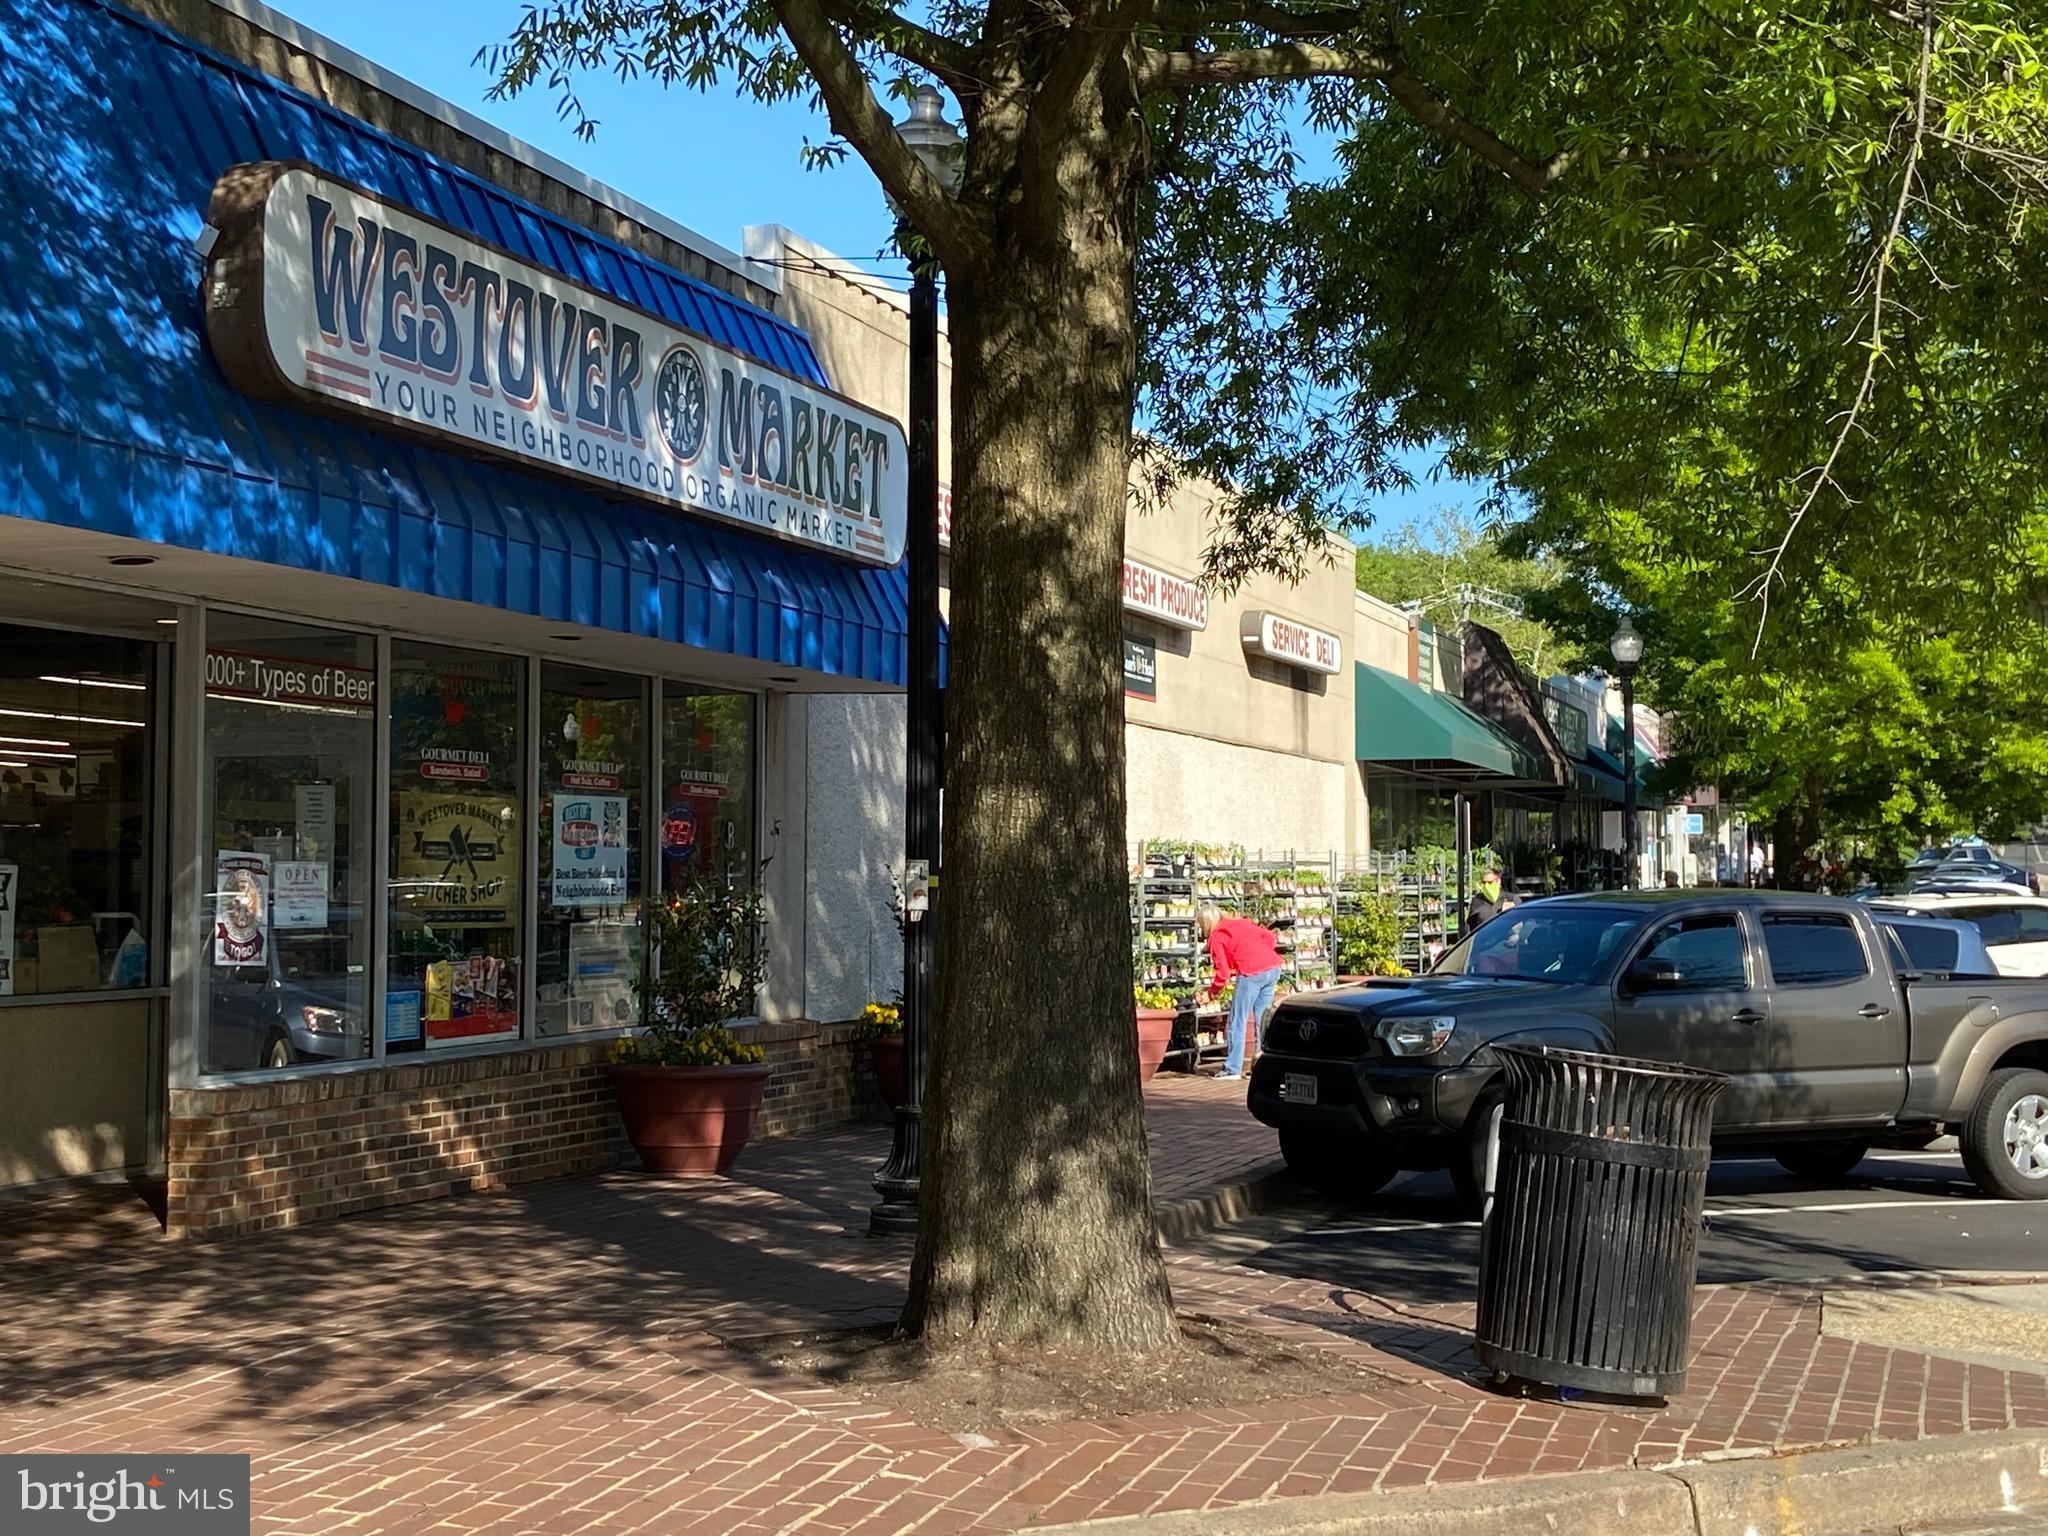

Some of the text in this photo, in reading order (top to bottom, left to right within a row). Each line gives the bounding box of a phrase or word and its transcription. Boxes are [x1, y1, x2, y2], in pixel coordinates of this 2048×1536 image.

[306, 194, 890, 527] WESTOVER MARKET
[375, 372, 853, 550] YOUR NEIGHBORHOOD ORGANIC MARKET
[1123, 563, 1205, 624] RESH PRODUCE
[1271, 619, 1335, 667] SERVICE DELI
[250, 659, 307, 698] Types
[311, 668, 331, 696] of
[333, 669, 376, 701] Beer
[420, 747, 490, 764] GOURMET DELI
[561, 758, 600, 772] GOURMET
[418, 802, 503, 832] WESTOVER MARKET
[284, 867, 320, 881] OPEN
[470, 875, 503, 902] SHOP
